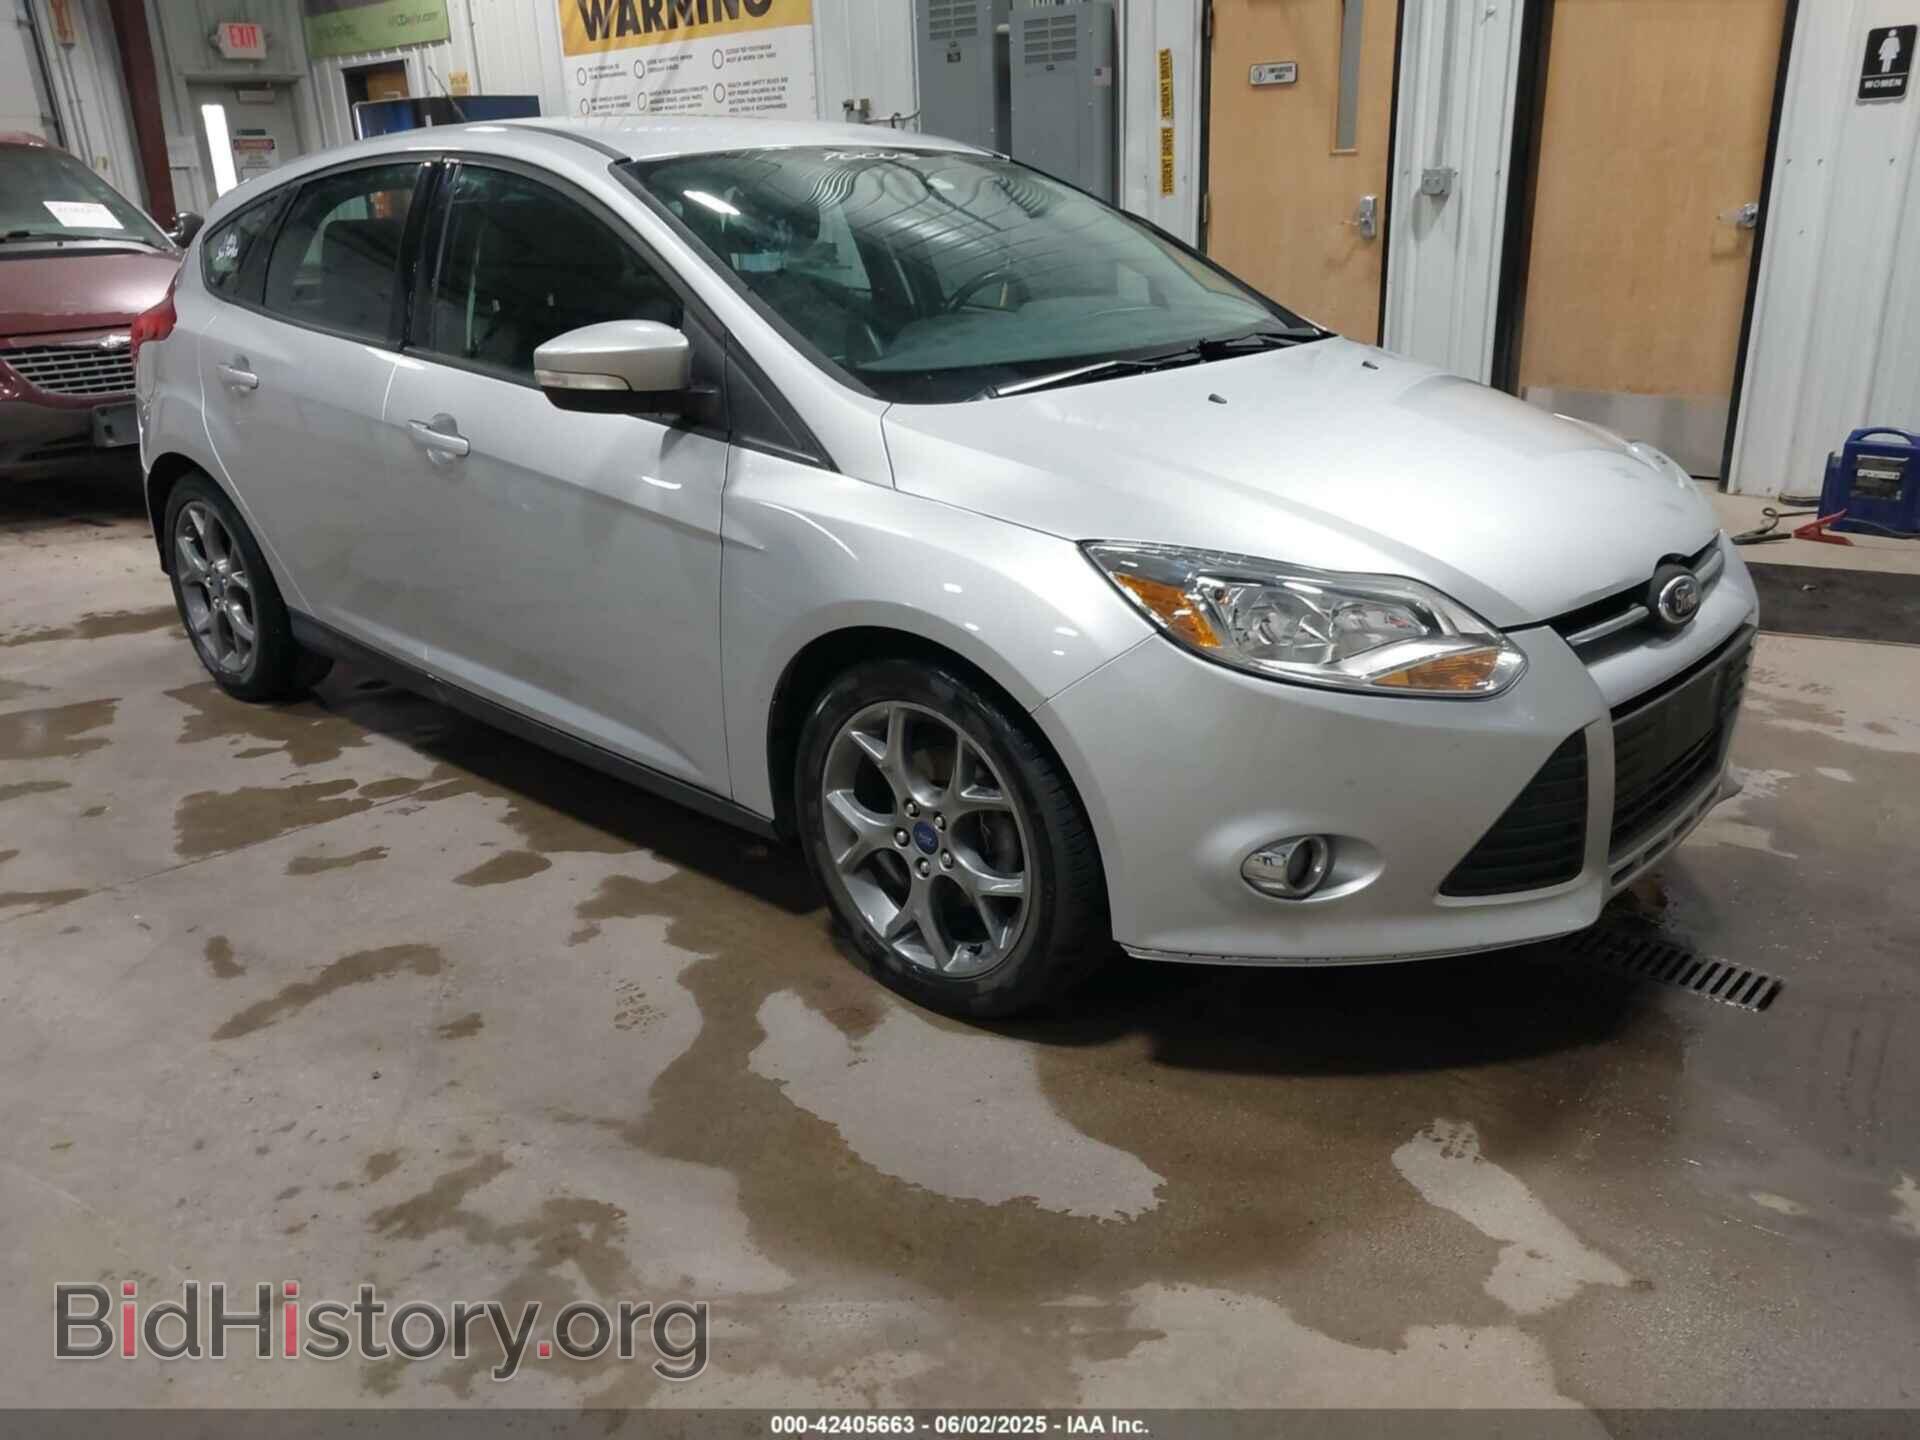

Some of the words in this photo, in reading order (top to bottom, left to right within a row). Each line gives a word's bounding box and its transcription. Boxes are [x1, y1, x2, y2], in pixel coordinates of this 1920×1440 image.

[228, 24, 257, 49] EXIT
[1159, 49, 1170, 80] DRIVER
[1864, 78, 1903, 89] WOMEN
[1160, 81, 1170, 118] STUDENT
[1161, 128, 1173, 157] DRIVER
[1161, 159, 1173, 192] STUDENT
